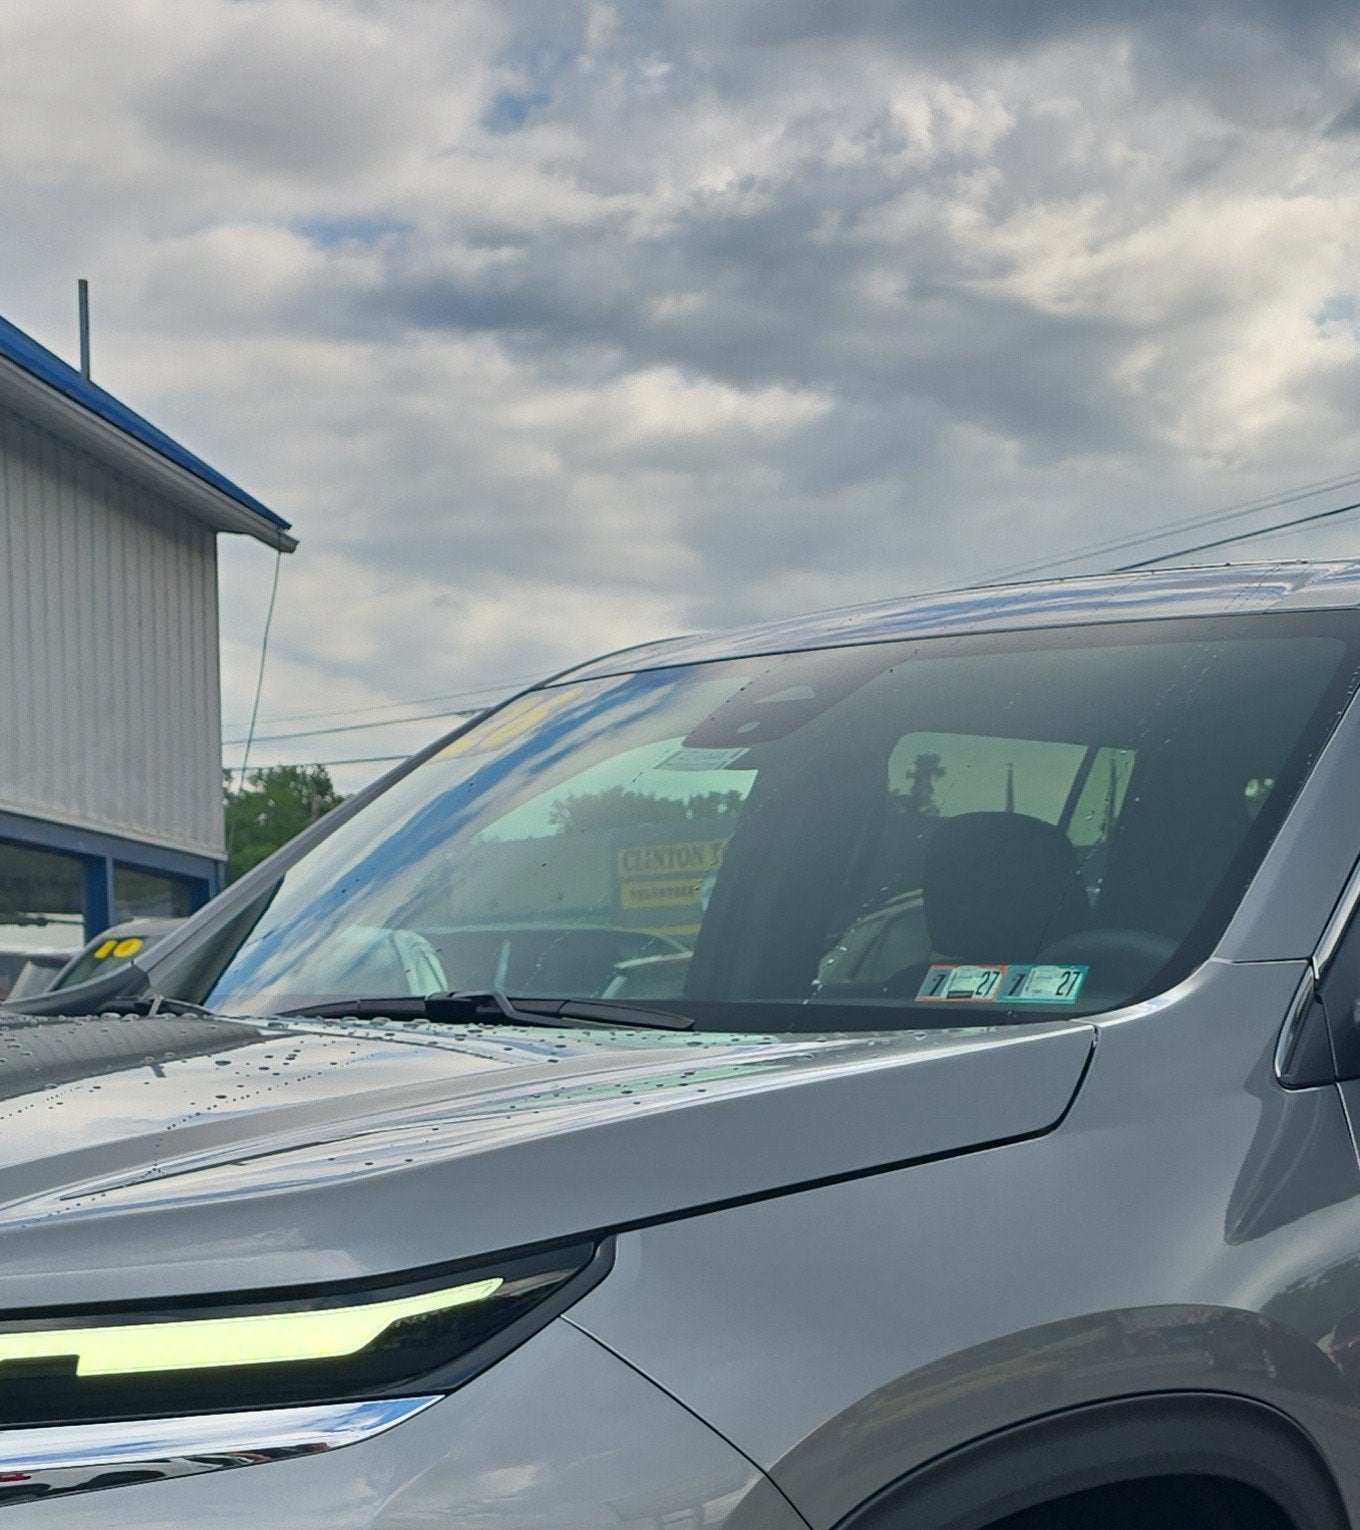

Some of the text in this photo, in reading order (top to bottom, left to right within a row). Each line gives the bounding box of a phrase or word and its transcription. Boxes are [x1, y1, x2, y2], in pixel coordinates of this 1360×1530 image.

[622, 843, 704, 873] CLINTON
[976, 971, 1001, 996] 27
[1056, 971, 1081, 996] 27
